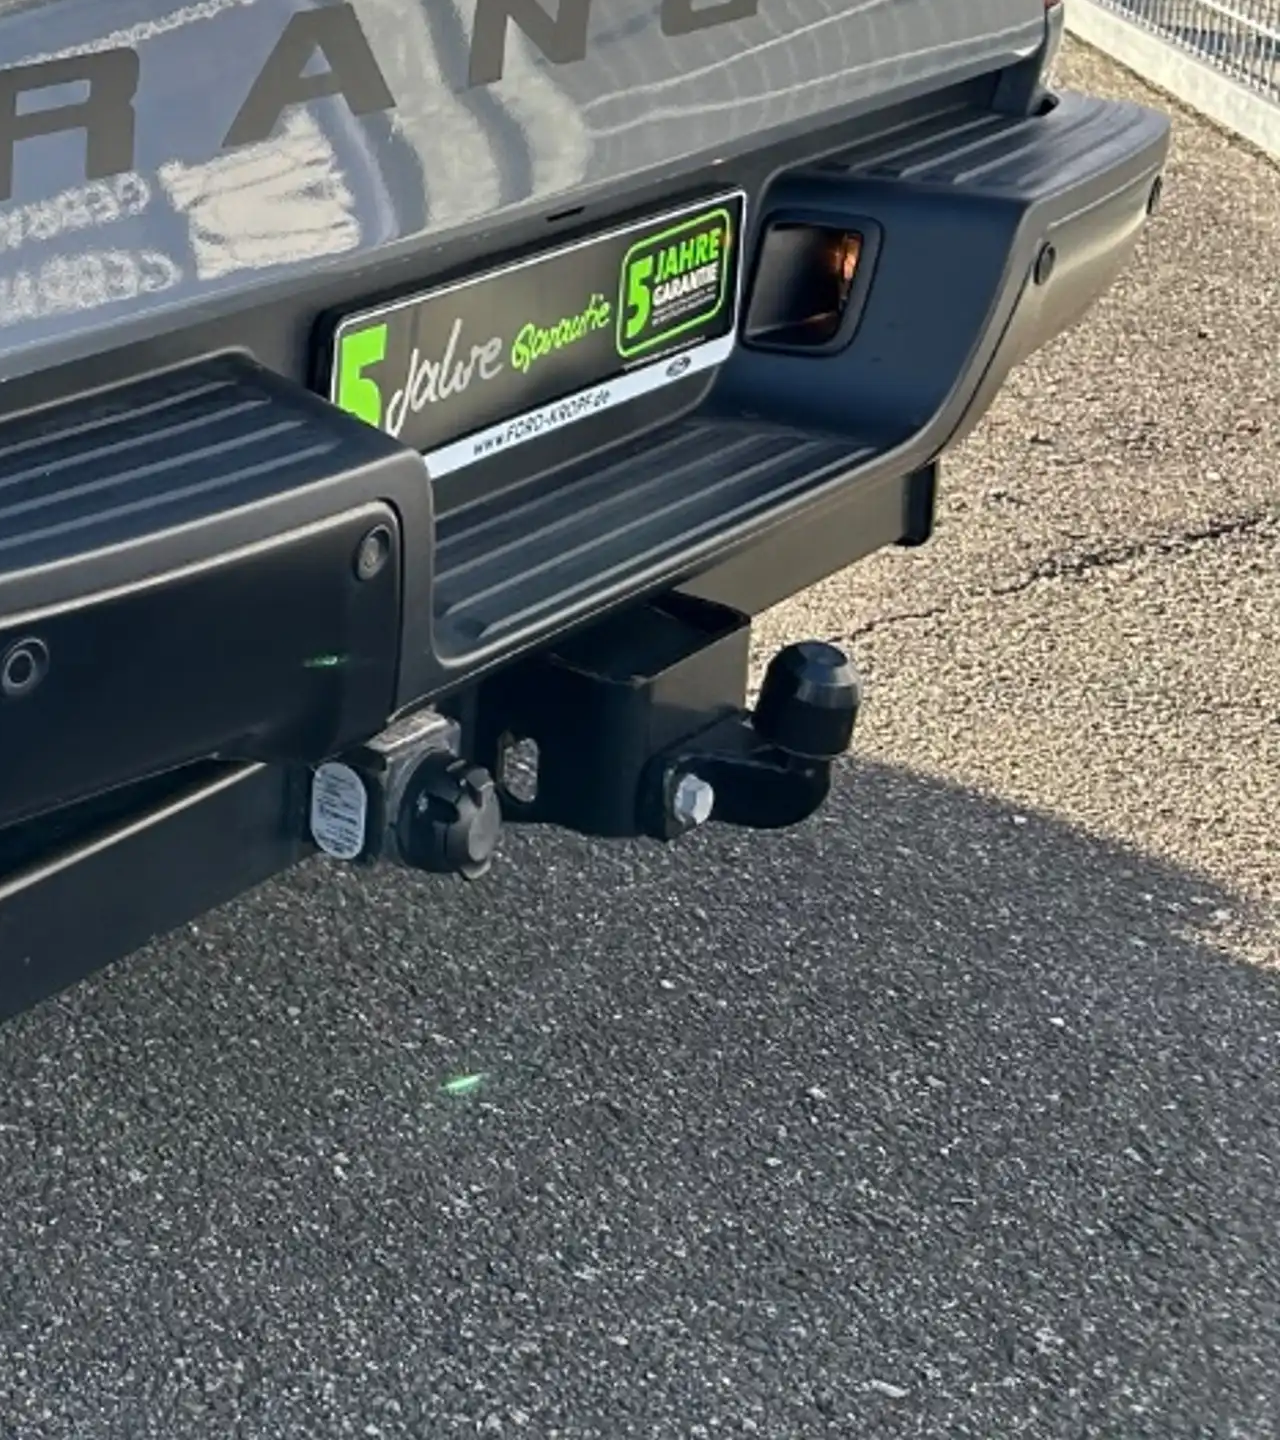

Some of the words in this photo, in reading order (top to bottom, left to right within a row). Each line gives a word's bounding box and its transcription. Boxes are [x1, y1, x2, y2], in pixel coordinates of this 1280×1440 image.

[626, 255, 653, 339] 5
[654, 227, 721, 284] JAHRE
[340, 324, 387, 428] 5
